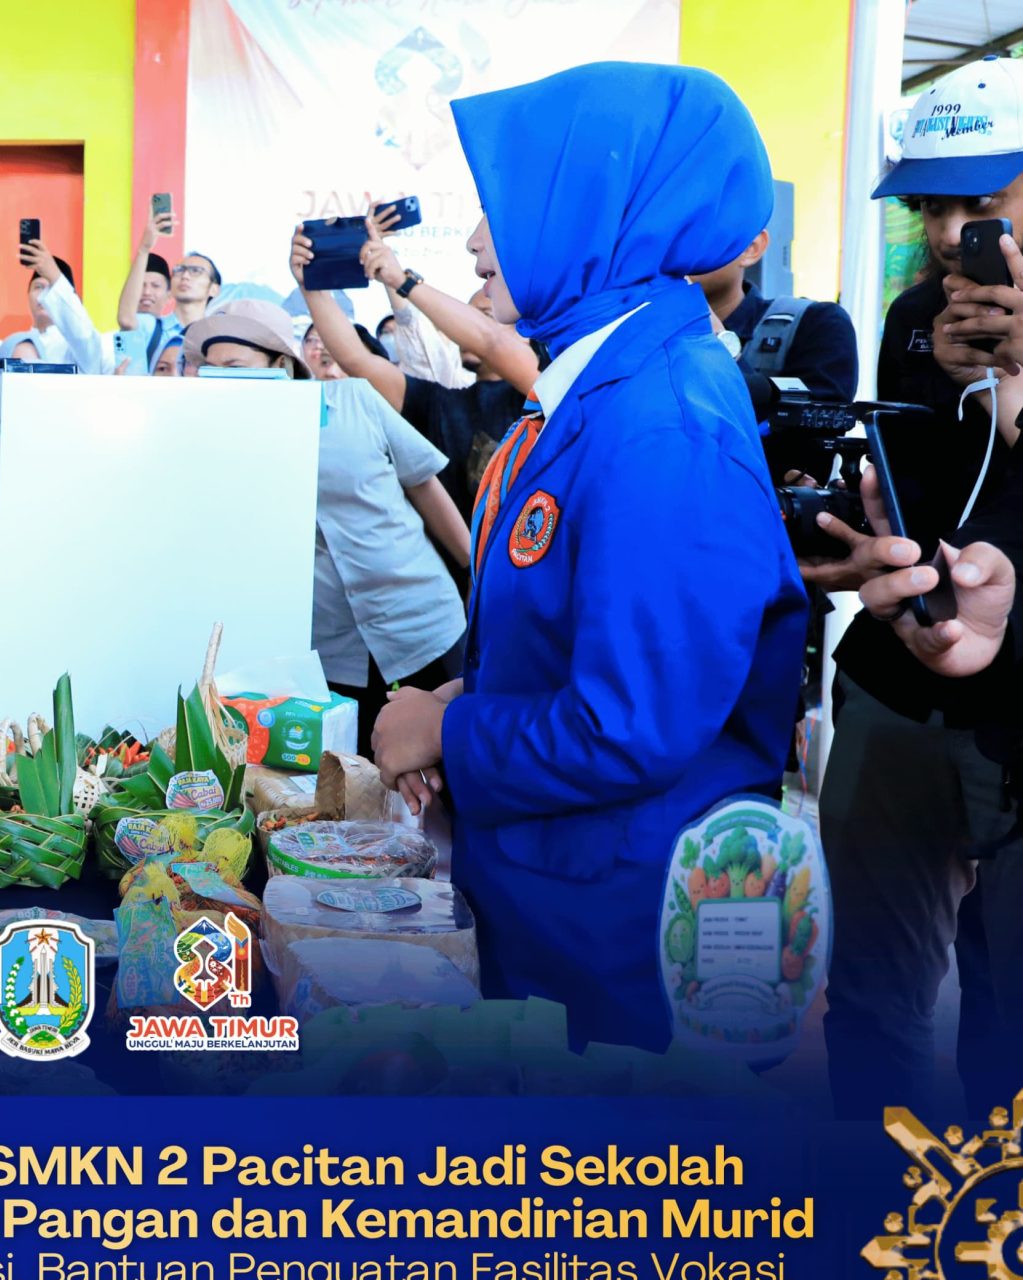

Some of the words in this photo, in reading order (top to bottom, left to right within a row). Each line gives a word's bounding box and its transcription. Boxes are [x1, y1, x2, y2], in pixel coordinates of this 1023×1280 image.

[931, 103, 961, 117] 1999
[941, 120, 994, 141] Member
[191, 787, 217, 800] Cabai
